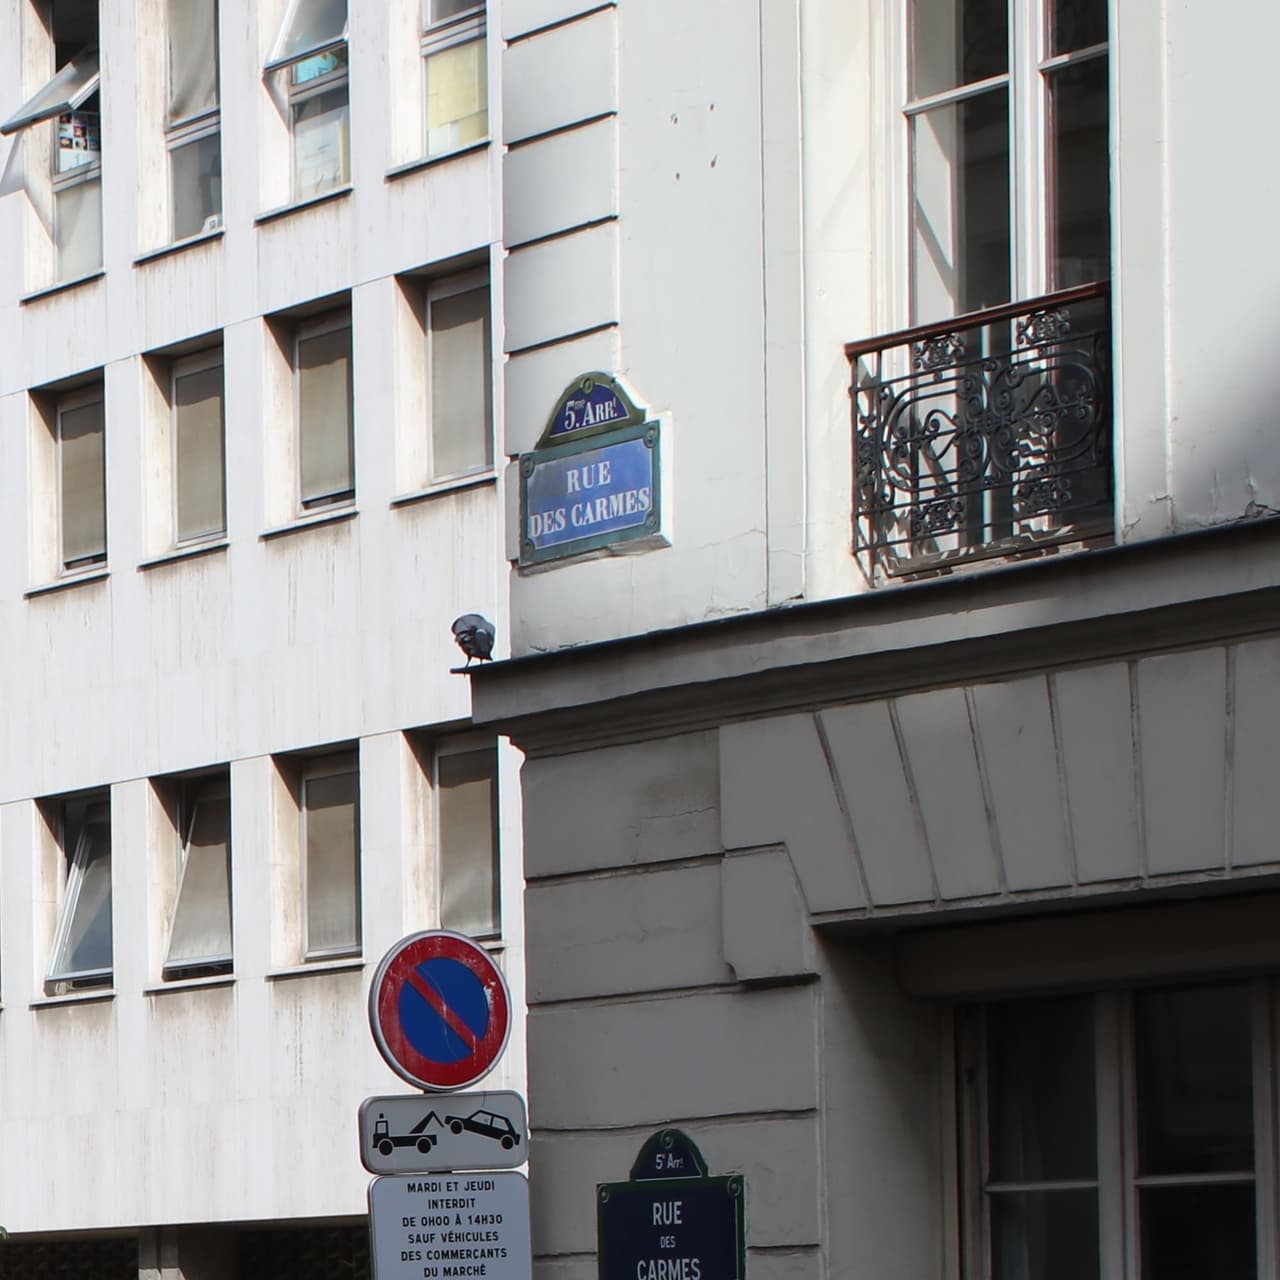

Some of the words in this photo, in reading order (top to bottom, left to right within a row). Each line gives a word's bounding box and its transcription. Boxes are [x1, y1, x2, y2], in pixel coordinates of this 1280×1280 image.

[566, 461, 611, 494] RUE
[529, 507, 567, 538] DES
[571, 487, 650, 528] CARMES
[407, 1182, 441, 1193] MARDI
[446, 1182, 458, 1192] ET
[464, 1181, 495, 1192] JEUDI
[428, 1198, 476, 1209] INTERDIT
[402, 1217, 416, 1227] DE
[421, 1216, 450, 1226] 0H00
[455, 1213, 462, 1225] À
[468, 1214, 503, 1225] 14H30
[652, 1201, 683, 1226] RUE
[408, 1233, 436, 1244] SAUF
[440, 1230, 499, 1243] VÉHICULES
[660, 1235, 676, 1249] DES
[401, 1250, 422, 1261] DES
[423, 1267, 438, 1278] DU
[443, 1264, 487, 1277] MARCHÉ
